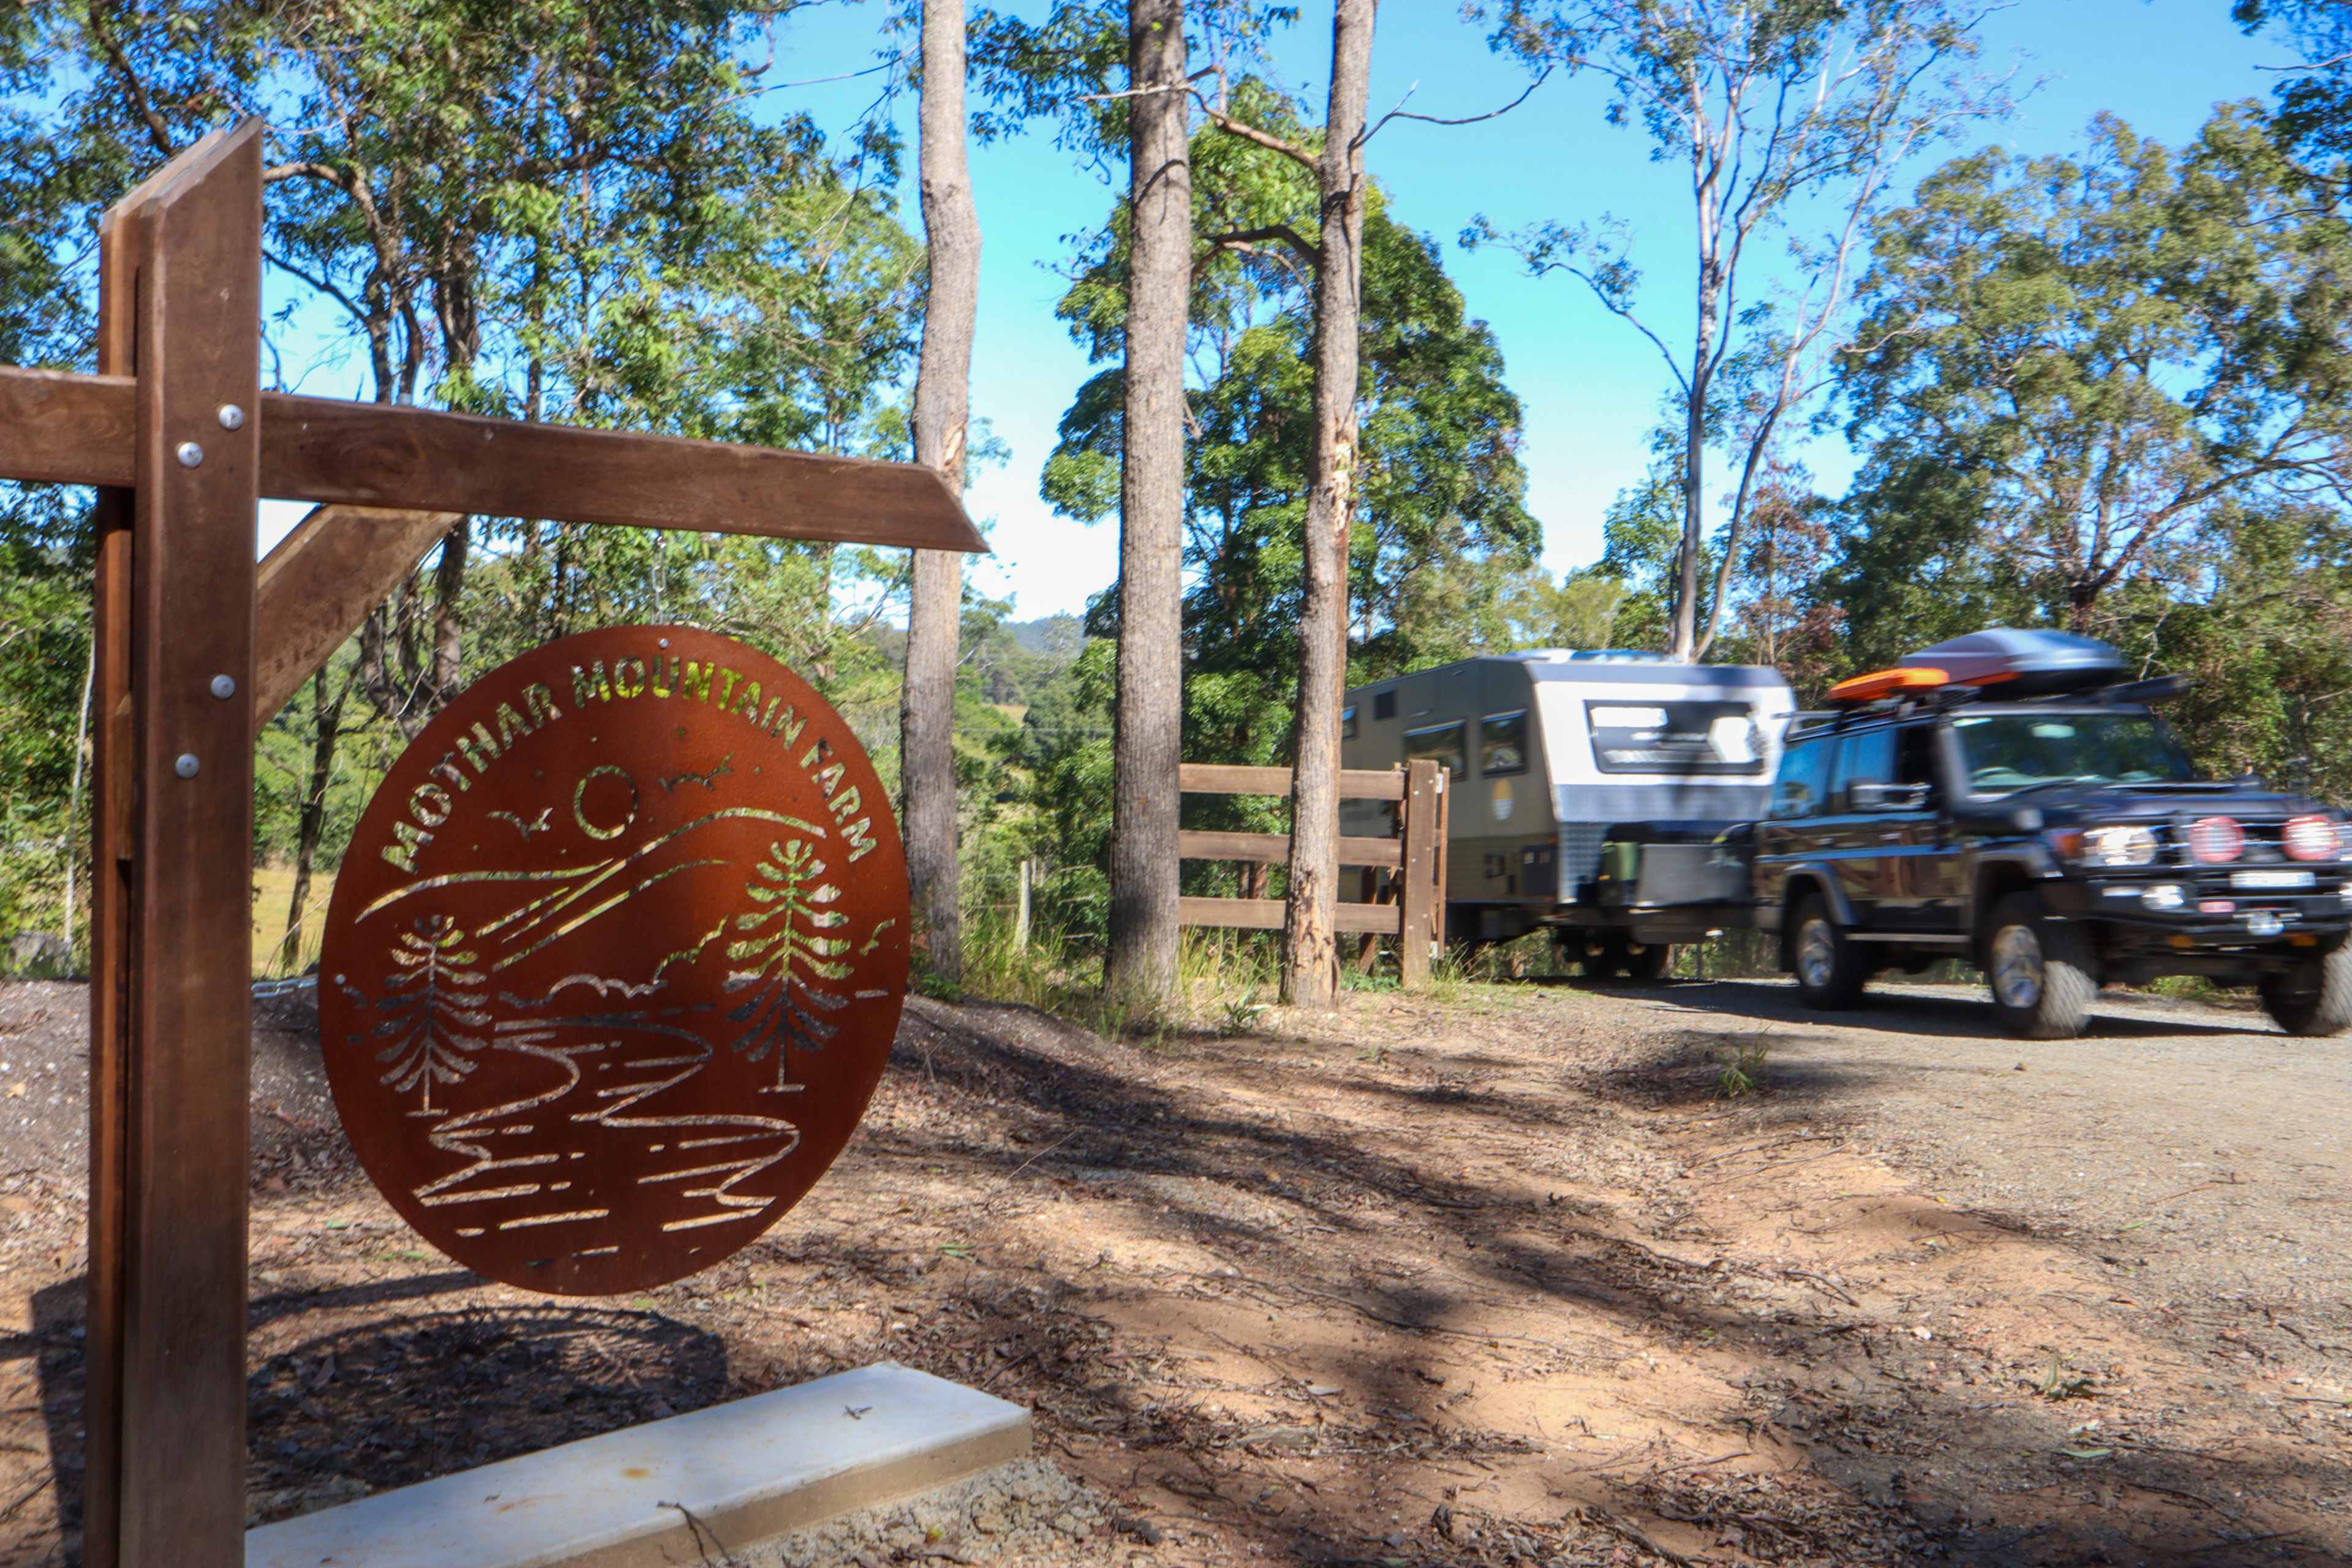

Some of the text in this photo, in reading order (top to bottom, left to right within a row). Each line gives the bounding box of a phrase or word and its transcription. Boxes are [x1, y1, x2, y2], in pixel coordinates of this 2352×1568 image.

[382, 655, 878, 874] MOTHAR MOUNTAIN FARM
